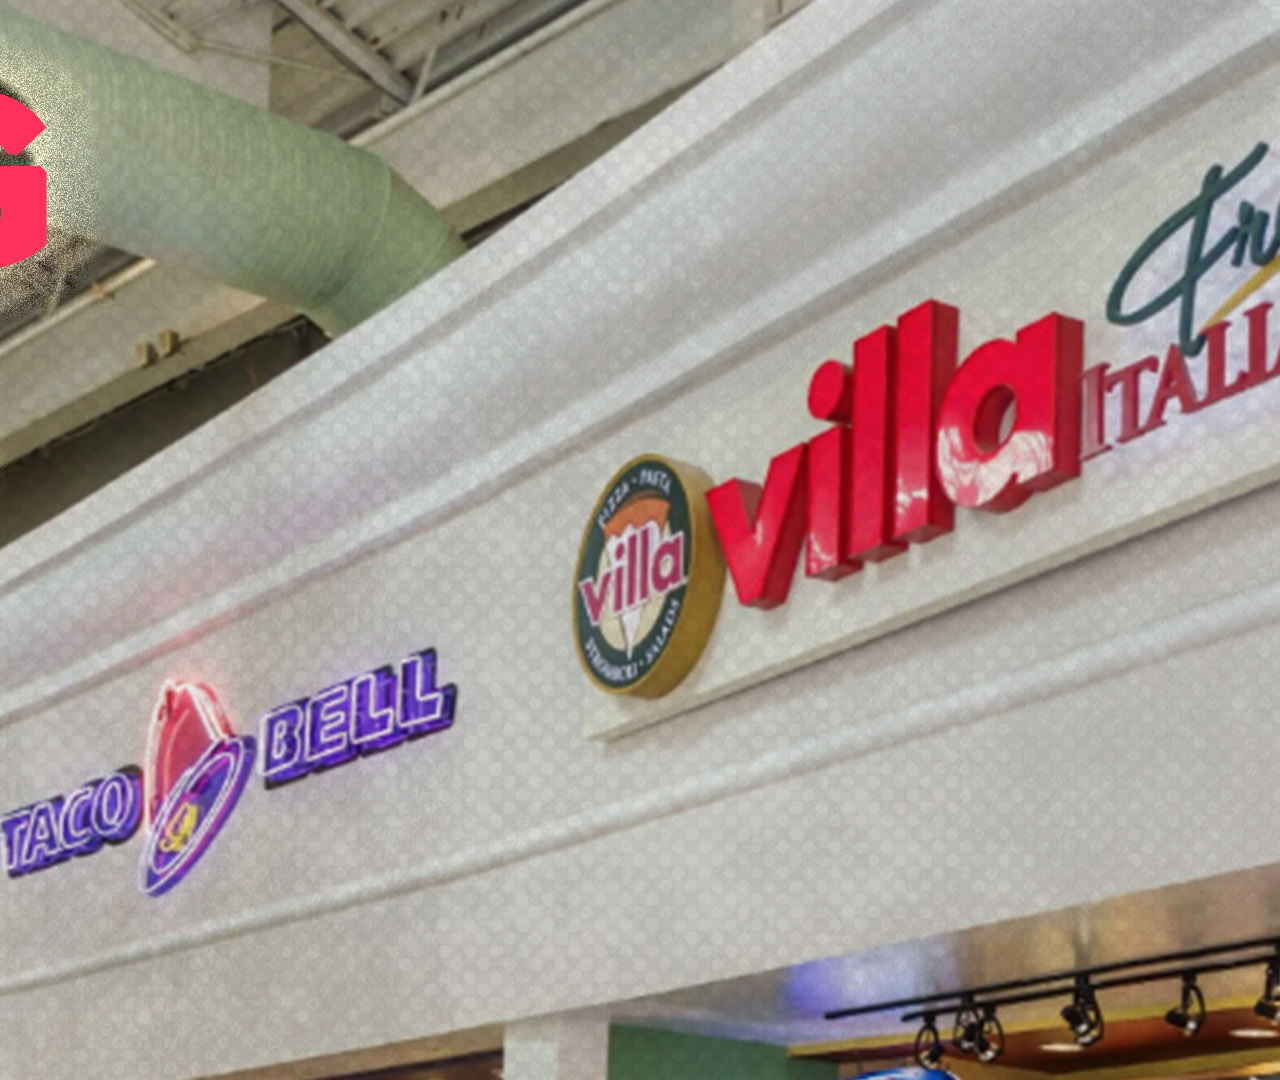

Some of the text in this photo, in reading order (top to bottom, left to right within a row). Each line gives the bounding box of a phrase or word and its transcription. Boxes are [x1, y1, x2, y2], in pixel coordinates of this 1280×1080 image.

[596, 468, 674, 528] PIZZA PASTA
[705, 298, 1084, 611] villa
[578, 526, 689, 628] villa
[256, 647, 458, 790] BELL
